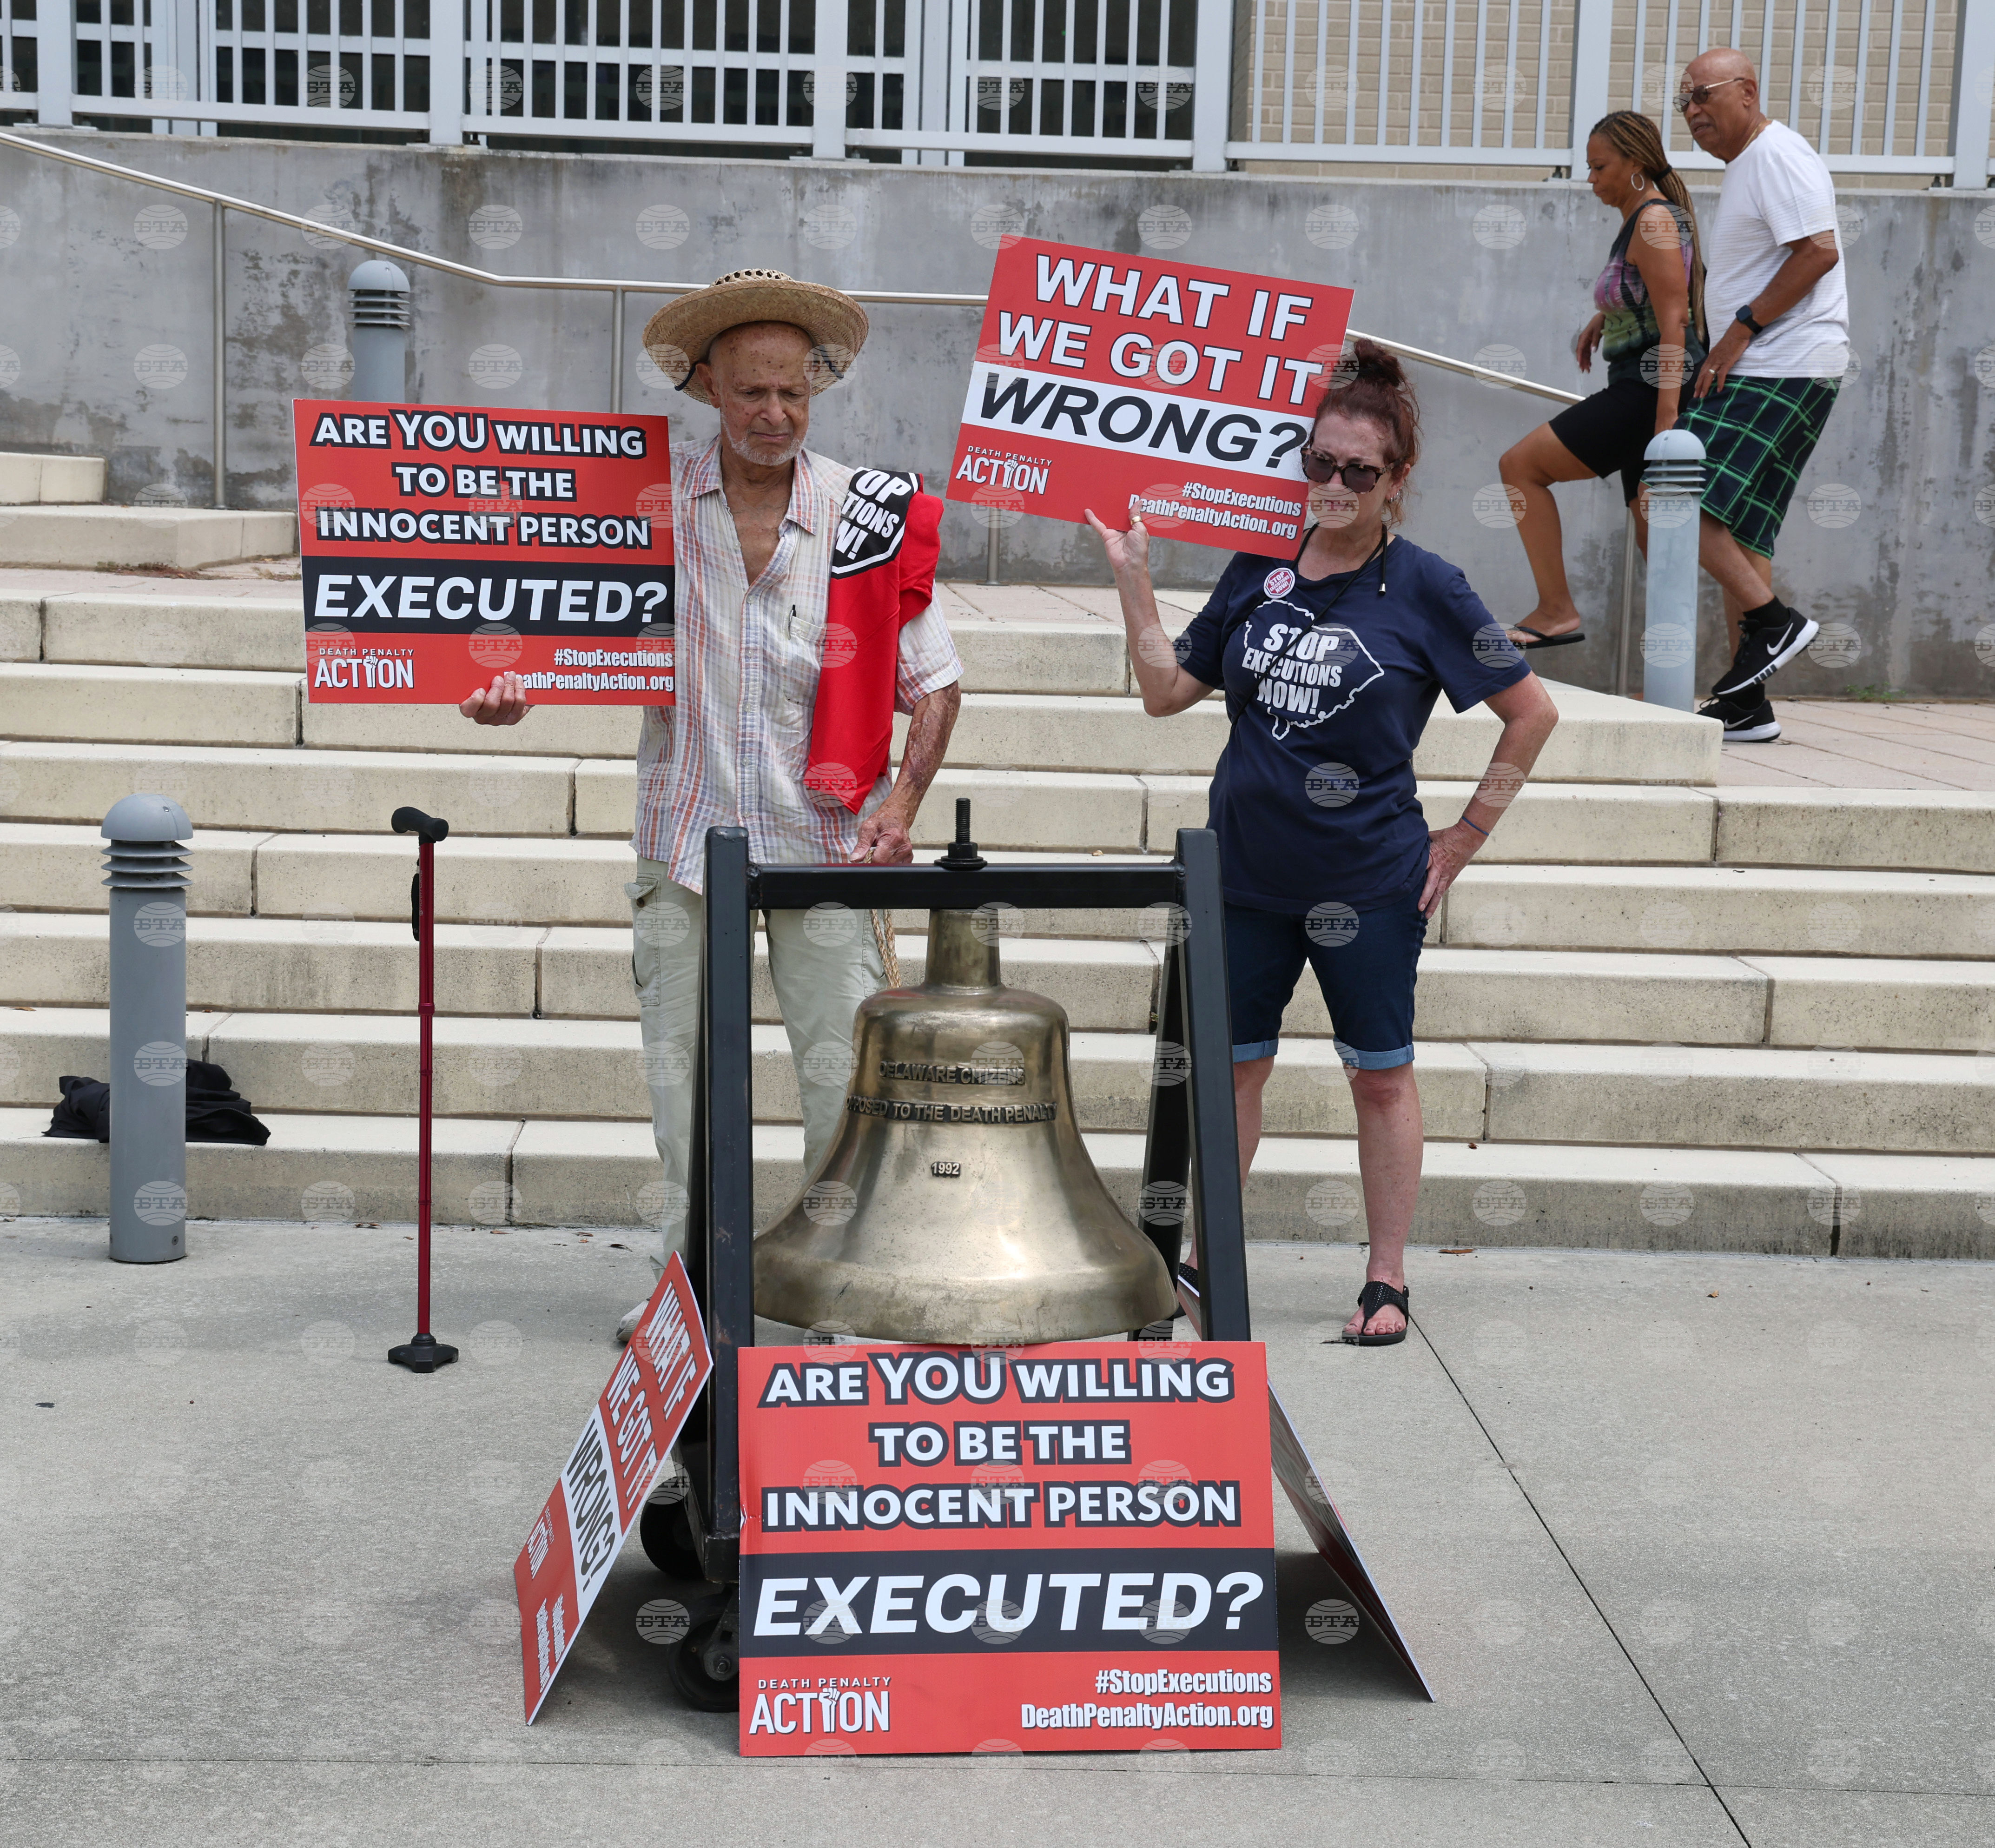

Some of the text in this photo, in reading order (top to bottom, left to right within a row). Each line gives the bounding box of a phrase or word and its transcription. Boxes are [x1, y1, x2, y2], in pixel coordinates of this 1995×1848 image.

[1037, 254, 1312, 340] WHAT IF
[998, 310, 1323, 404] WE GOT IT
[316, 414, 642, 455] ARE YOU WILLING
[979, 372, 1308, 469] WRONG?
[967, 445, 1052, 466] DEATH PENALTY
[396, 467, 573, 497] TO BE THE
[1182, 481, 1302, 517] #StopExecutions
[320, 511, 648, 545] INNOCENT PERSON
[1269, 571, 1285, 586] STOP
[1275, 580, 1289, 593] NOW!
[314, 575, 667, 623] EXECUTED?
[318, 646, 415, 656] DEATH PENALTY
[553, 647, 675, 669] #StopExecutions
[1263, 623, 1340, 662] STOP
[503, 670, 675, 693] athPenaltyAction.org
[1242, 647, 1342, 688] EXECUTIONS
[1256, 677, 1320, 715] NOW!
[879, 1060, 1025, 1085] DELAWARE CITIZENS
[893, 1103, 911, 1119] TO
[915, 1105, 944, 1121] THE
[951, 1106, 1001, 1123] DEATH
[931, 1161, 961, 1175] 1992
[645, 1280, 697, 1421] WHAT IF
[606, 1345, 641, 1427] WE
[766, 1357, 1229, 1402] ARE YOU WILLING
[617, 1388, 653, 1478] GOT
[874, 1425, 1125, 1461] TO BE THE
[567, 1418, 615, 1593] WRONG?
[767, 1486, 1235, 1526] INNOCENT PERSON
[753, 1571, 1263, 1636] EXECUTED?
[758, 1676, 892, 1689] DEATH PENALTY
[1095, 1669, 1272, 1696] #StopExecutions
[1021, 1702, 1273, 1729] DeathPenaltyAction.org
